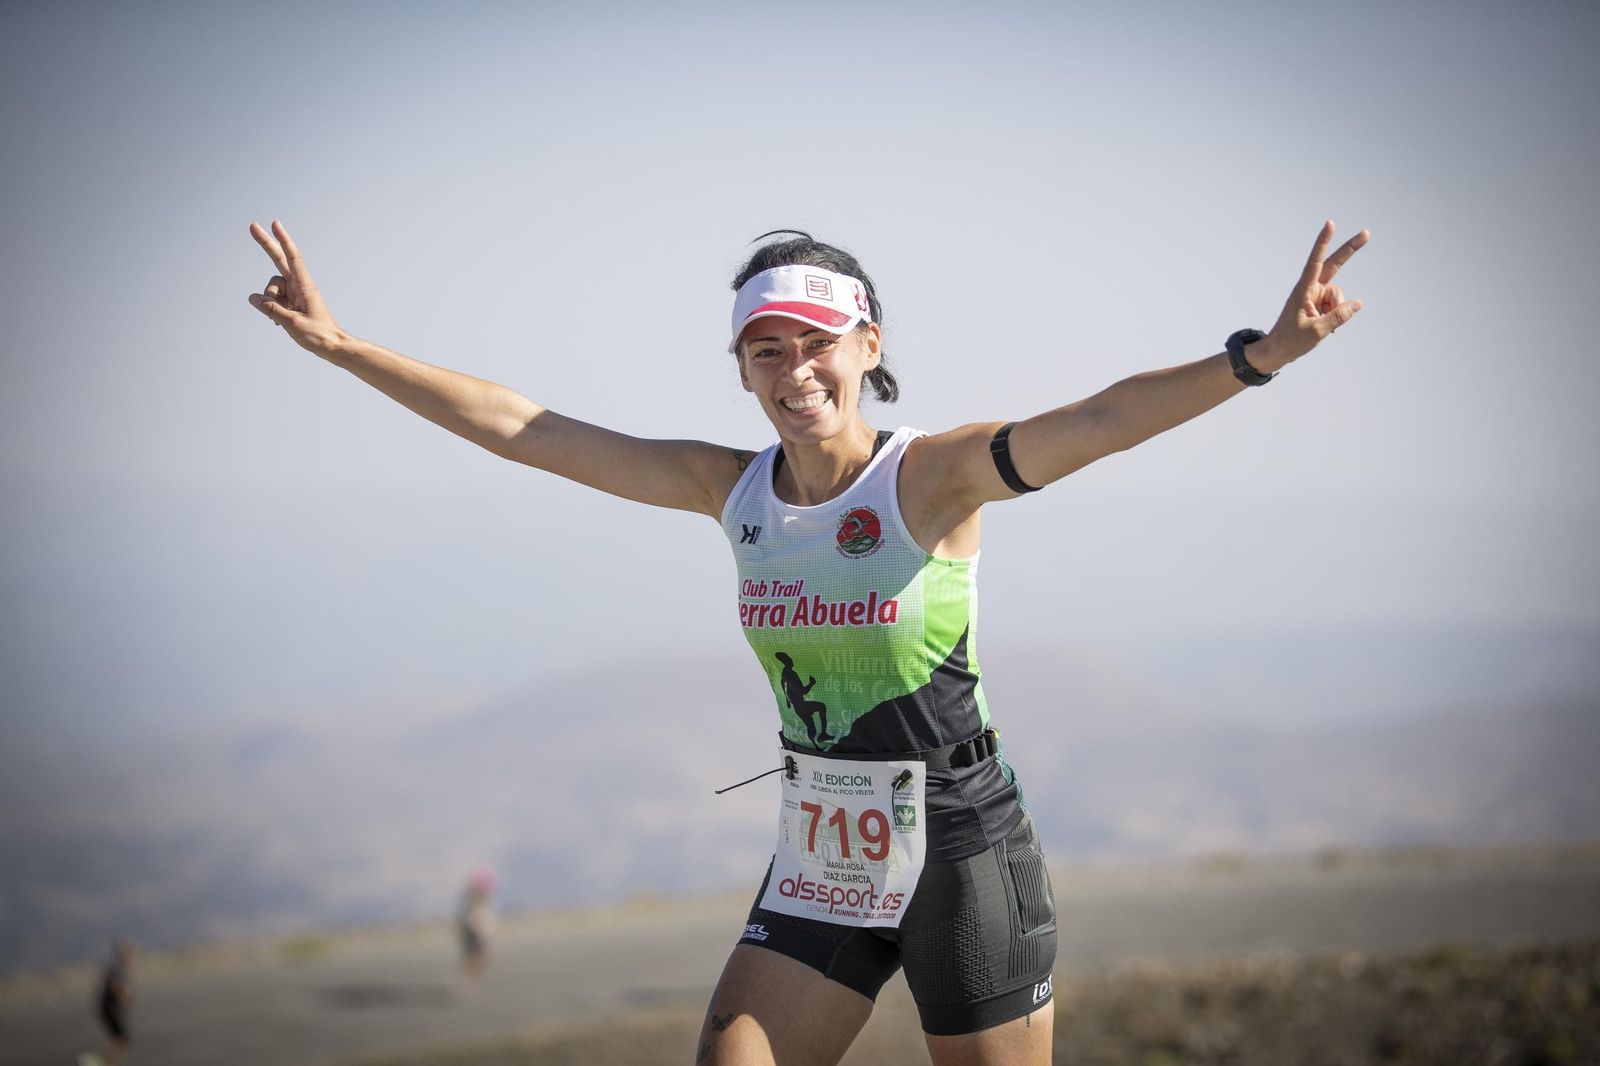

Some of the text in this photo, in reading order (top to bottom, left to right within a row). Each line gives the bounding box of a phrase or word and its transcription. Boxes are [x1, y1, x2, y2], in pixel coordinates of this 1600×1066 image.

[743, 579, 804, 597] Club Trail
[739, 591, 898, 627] erra Abuela
[812, 770, 823, 784] XIX
[825, 772, 872, 787] EDICIÓN
[800, 800, 890, 862] 719
[826, 860, 845, 870] MARIA
[846, 863, 865, 871] ROSA
[823, 870, 871, 884] DIAZ GARCIA
[778, 873, 905, 914] alssport.es
[805, 903, 828, 913] TIENDA
[834, 908, 859, 918] RUNNING
